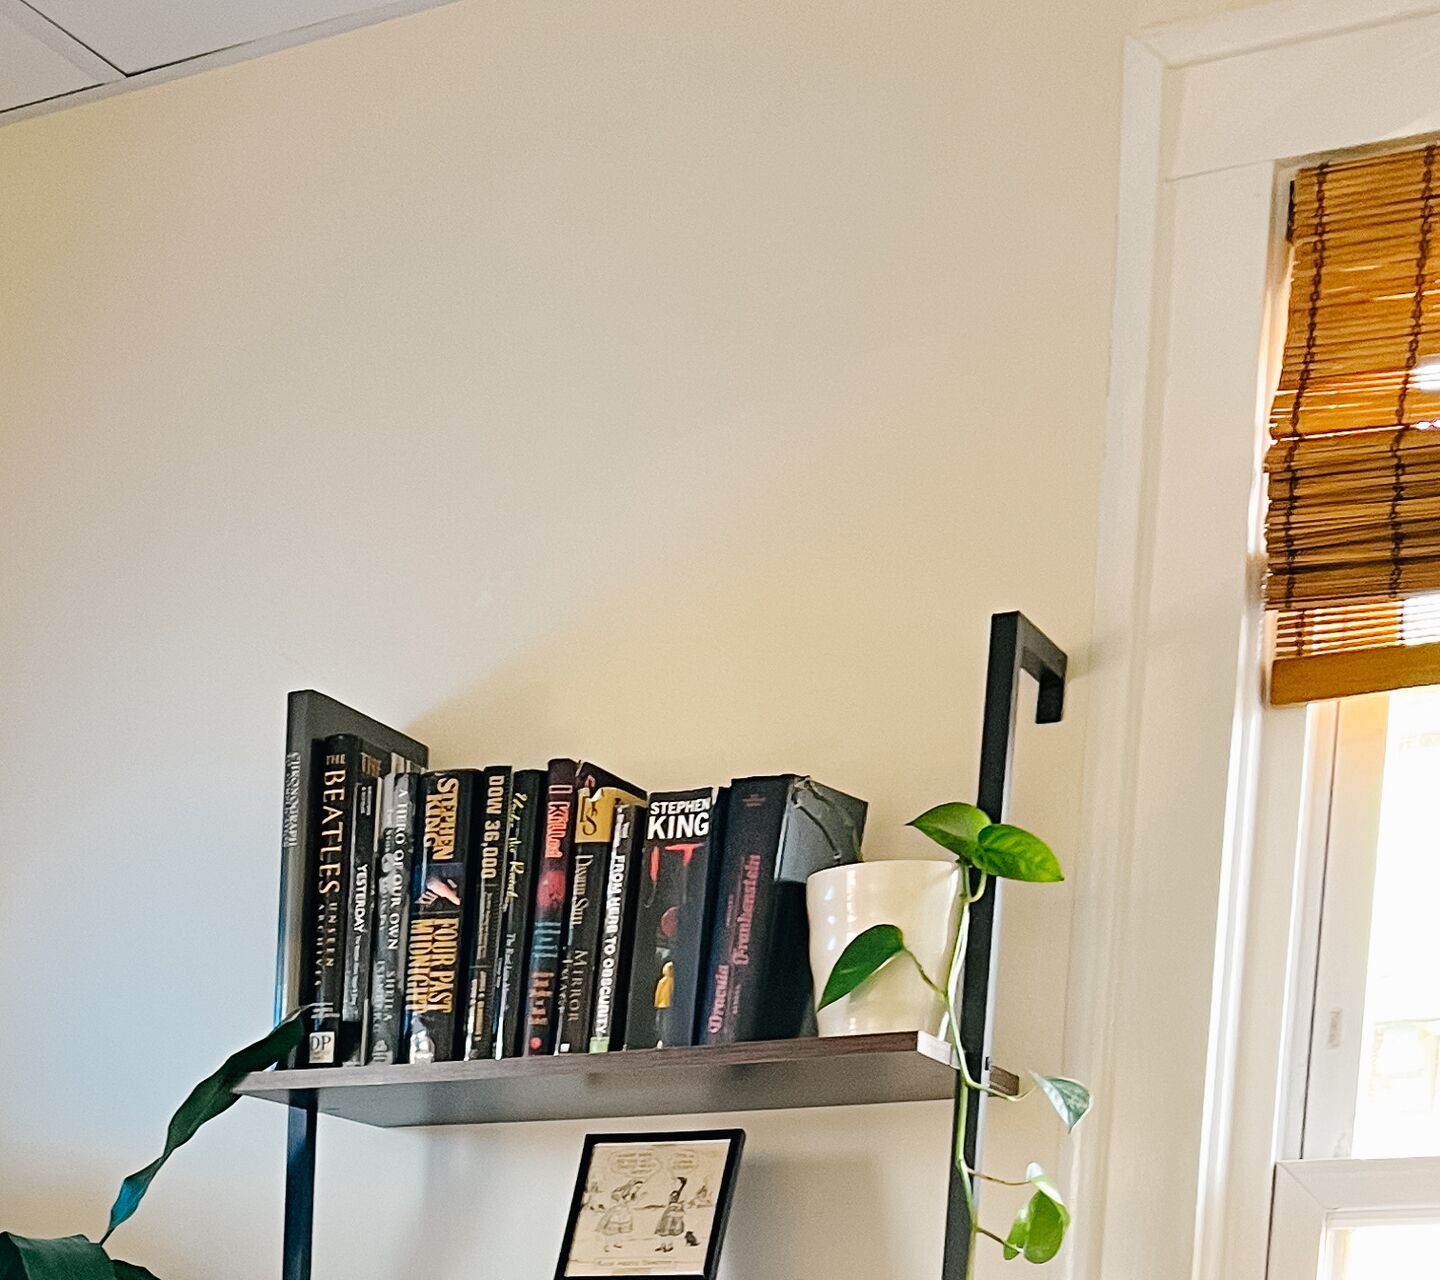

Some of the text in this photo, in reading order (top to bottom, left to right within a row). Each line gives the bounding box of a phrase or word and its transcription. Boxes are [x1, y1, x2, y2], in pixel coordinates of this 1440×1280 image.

[326, 753, 347, 766] THE
[398, 789, 409, 798] A
[486, 774, 506, 816] DOW
[650, 796, 712, 815] STEPHEN
[318, 769, 347, 895] BEATLES
[424, 794, 441, 849] KING
[432, 777, 460, 861] STEPHEN
[544, 800, 571, 859] Killed
[646, 812, 710, 840] KING
[392, 849, 405, 871] OF
[480, 820, 502, 880] 36,000
[649, 843, 705, 882] IT
[354, 863, 368, 934] YESTERDAY
[389, 873, 404, 907] OUR
[609, 854, 626, 895] FROM
[325, 902, 339, 967] UNSEEN
[387, 912, 400, 950] OWN
[606, 896, 623, 934] HERE
[405, 919, 434, 1014] MIDNIGHT
[427, 917, 460, 1014] FOUR PAST
[603, 936, 618, 956] TO
[568, 949, 589, 1022] MIRROR
[595, 958, 616, 1034] OBSCURITY
[708, 964, 730, 1034] Dracula
